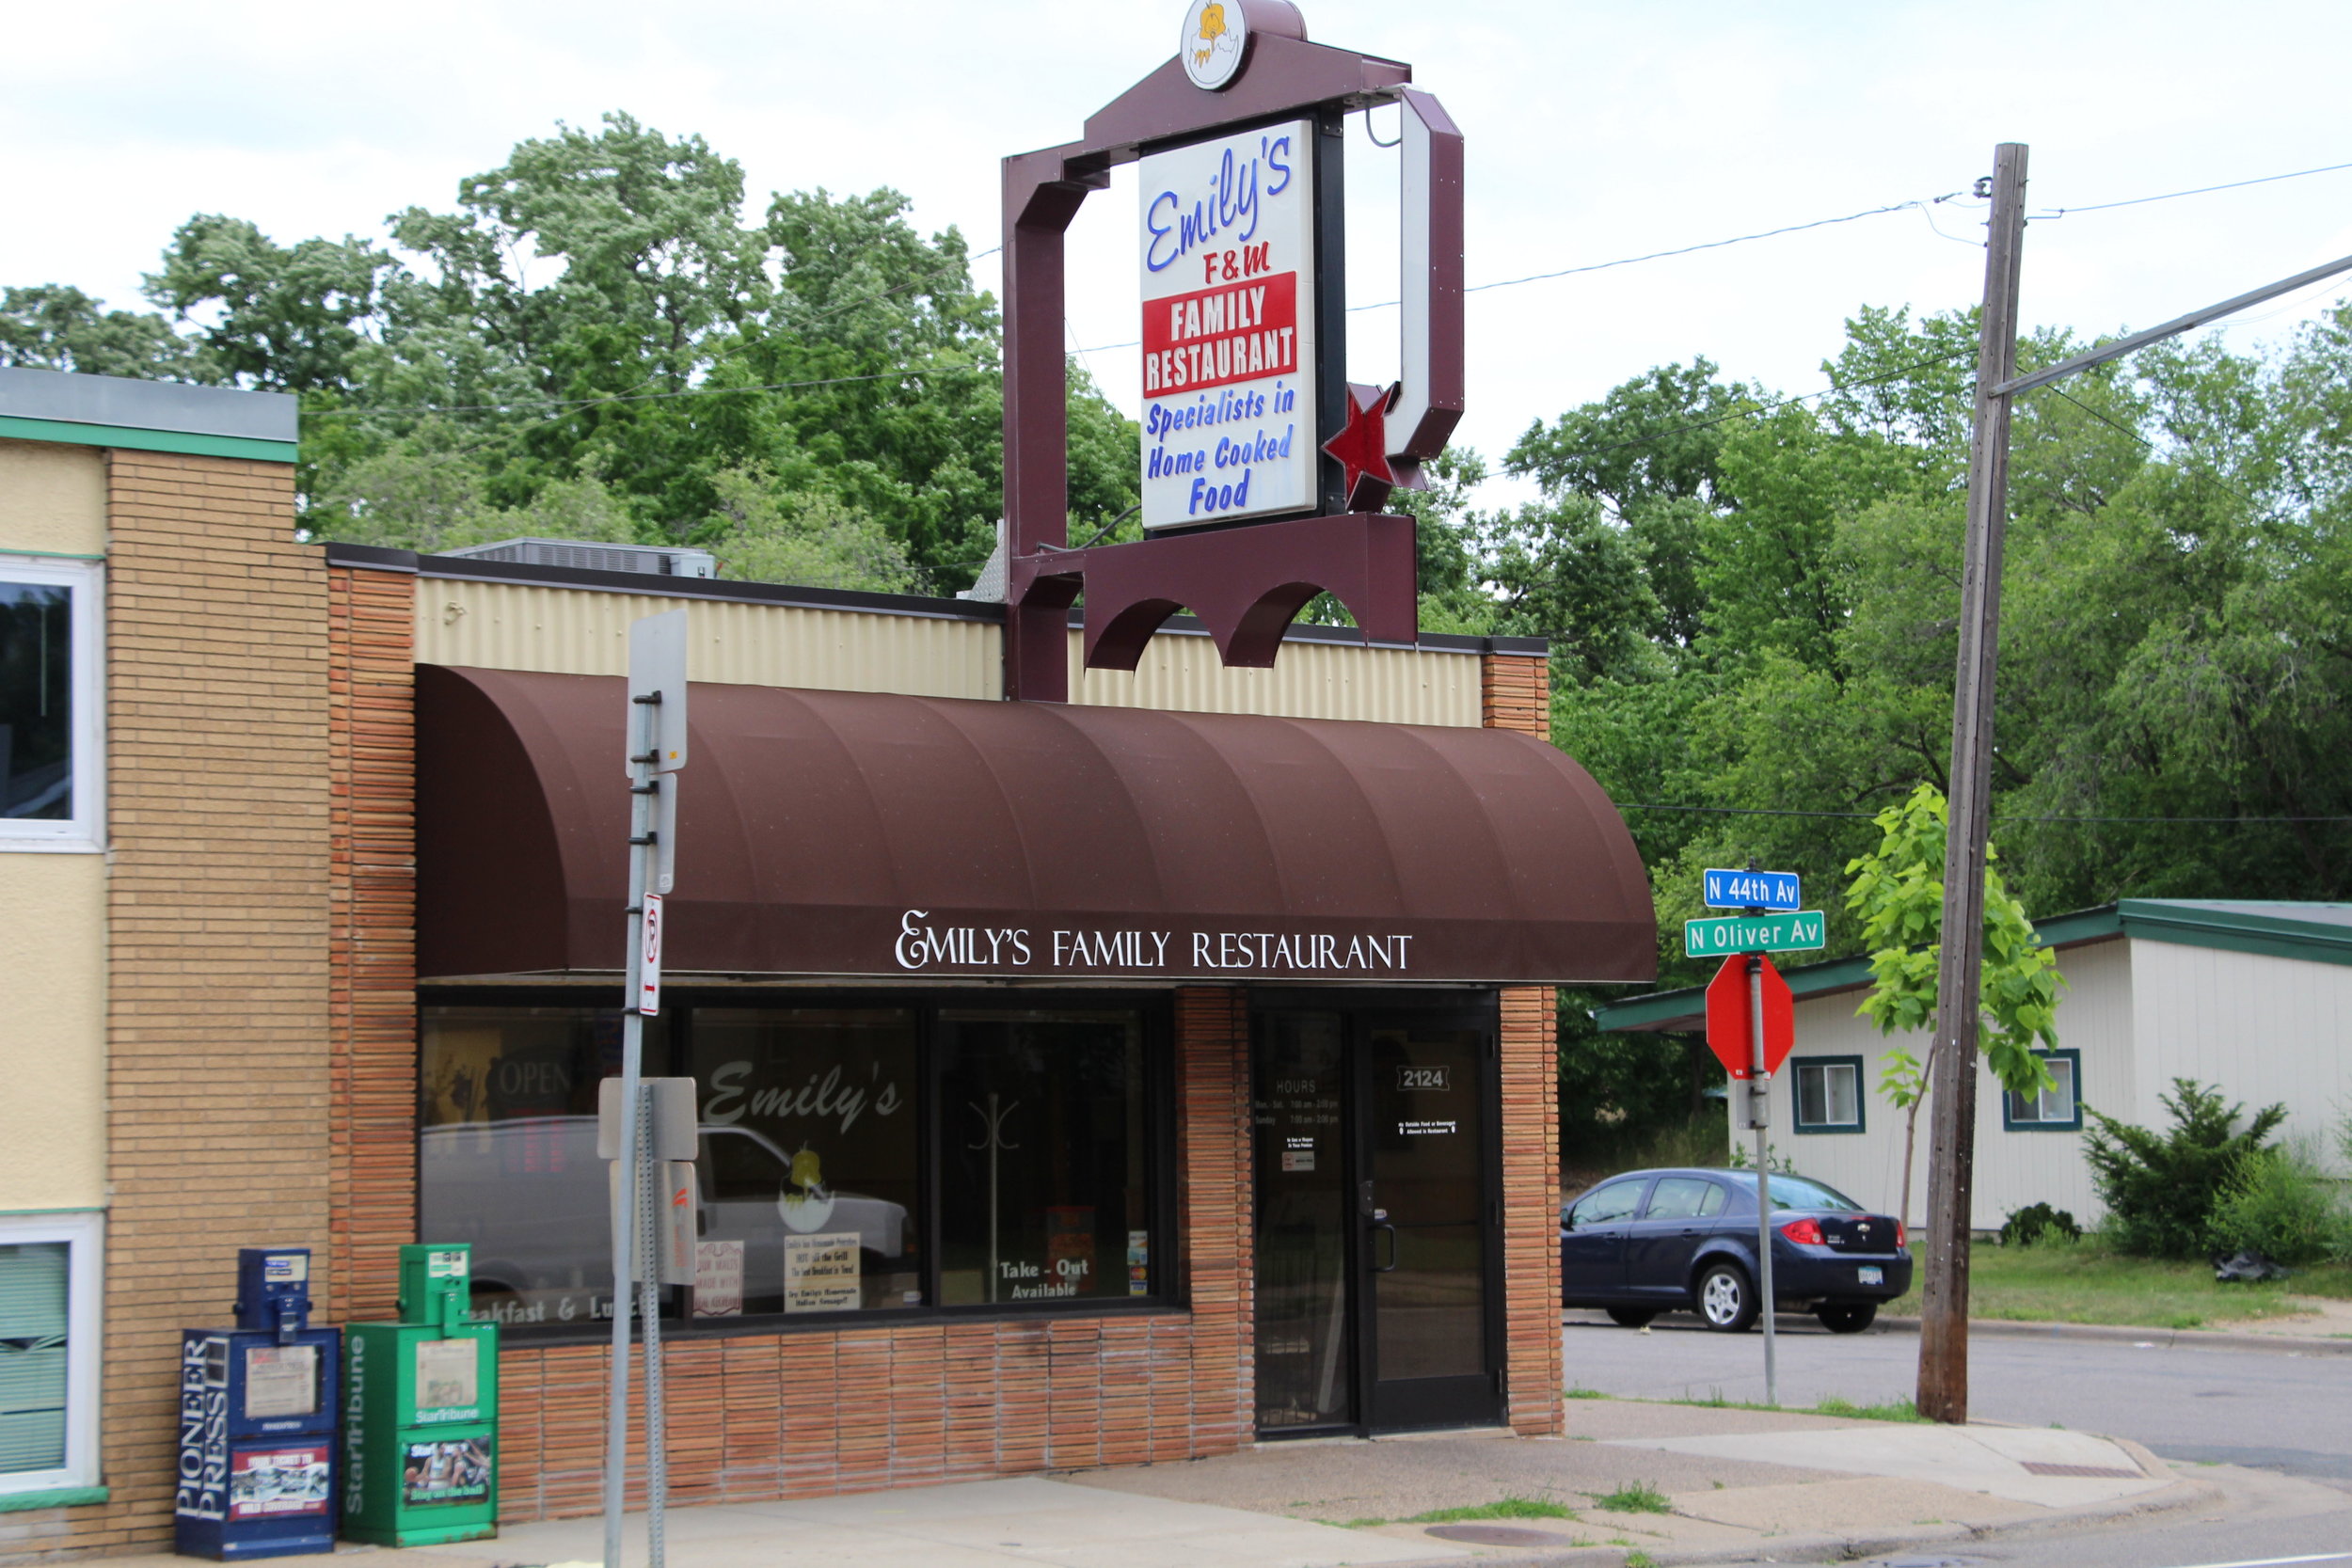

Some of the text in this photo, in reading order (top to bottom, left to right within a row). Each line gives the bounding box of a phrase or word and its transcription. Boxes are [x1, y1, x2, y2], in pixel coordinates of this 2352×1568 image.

[1147, 135, 1291, 272] Emily's
[1203, 241, 1271, 284] F&M
[1170, 285, 1266, 341] FAMILY
[1146, 326, 1294, 392] RESTAURANT
[1147, 380, 1295, 443] Specialists in
[1148, 424, 1294, 480] Home Cooked
[1189, 468, 1251, 515] Food
[1709, 877, 1795, 903] N 44th Av
[1053, 930, 1170, 967] FAMILY
[1193, 931, 1412, 971] RESTAURANT
[1692, 919, 1818, 949] N Oliver Av
[500, 1060, 572, 1094] OPEN
[703, 1060, 902, 1134] Emily's
[1276, 1079, 1316, 1094] HOURS
[1403, 1069, 1443, 1086] 2124
[821, 1252, 832, 1262] the
[834, 1251, 849, 1261] Grill
[1000, 1260, 1039, 1279] Take
[1056, 1259, 1089, 1276] Out
[469, 1299, 547, 1323] eakfast
[557, 1296, 577, 1320] &
[1011, 1282, 1077, 1299] Available
[176, 1339, 208, 1518] PIONEER
[346, 1336, 365, 1515] StarTribune
[415, 1407, 480, 1423] StarTribune
[199, 1391, 228, 1520] PRESS
[410, 1482, 485, 1500] Stay on the ball
